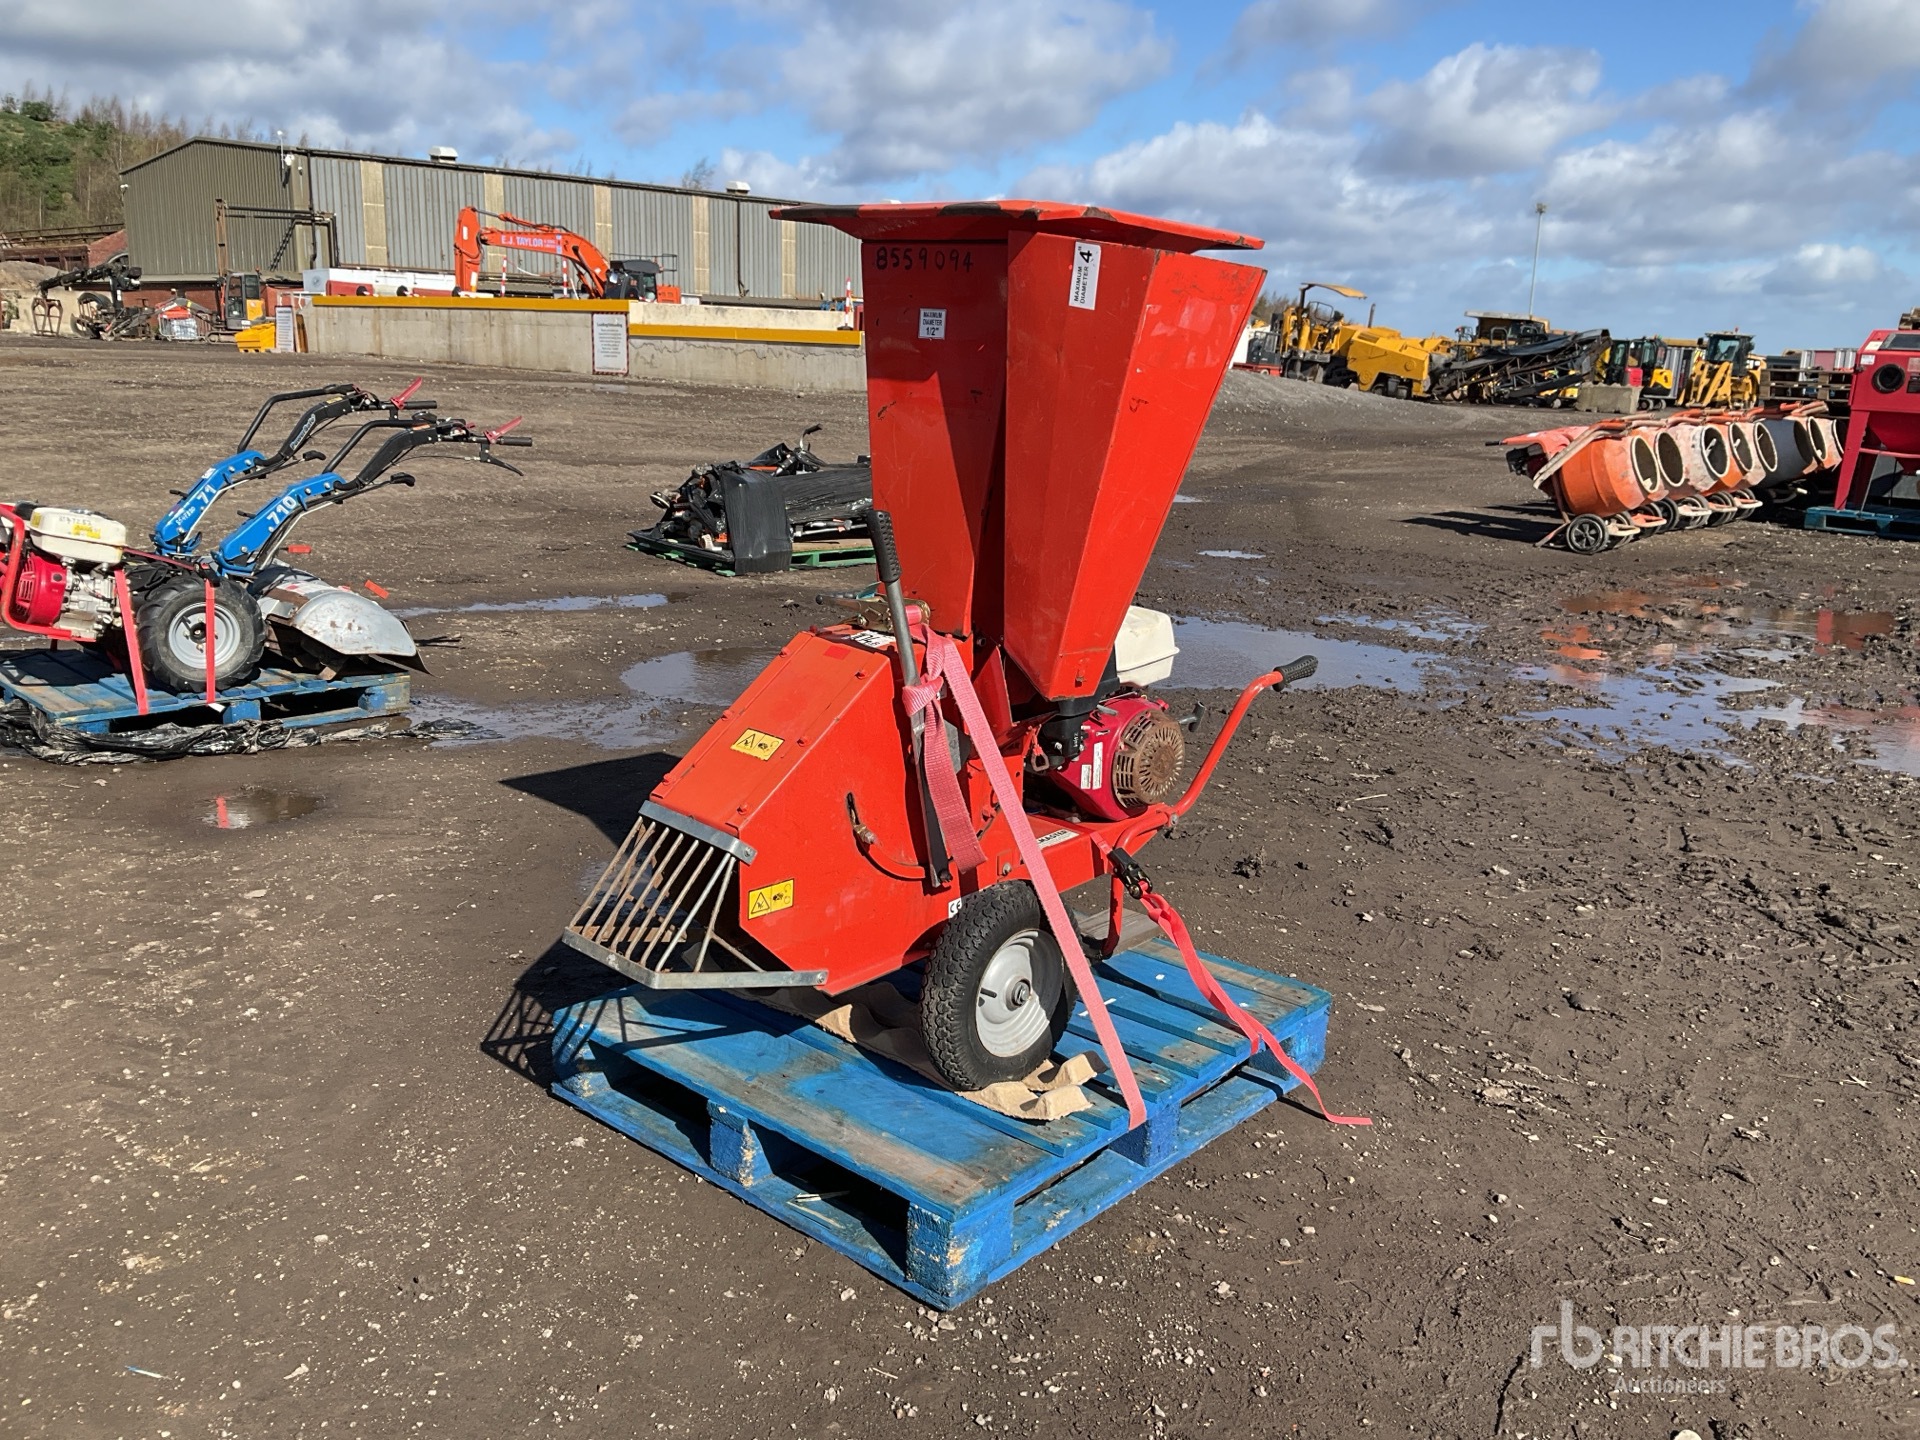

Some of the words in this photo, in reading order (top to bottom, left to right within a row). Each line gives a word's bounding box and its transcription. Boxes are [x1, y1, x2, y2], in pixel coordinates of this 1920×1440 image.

[516, 235, 544, 248] TAYLOR
[876, 246, 973, 273] 8559094
[1073, 266, 1083, 302] MAXIMUM
[1080, 265, 1089, 305] DIAMETER
[922, 318, 943, 326] DIAMETER
